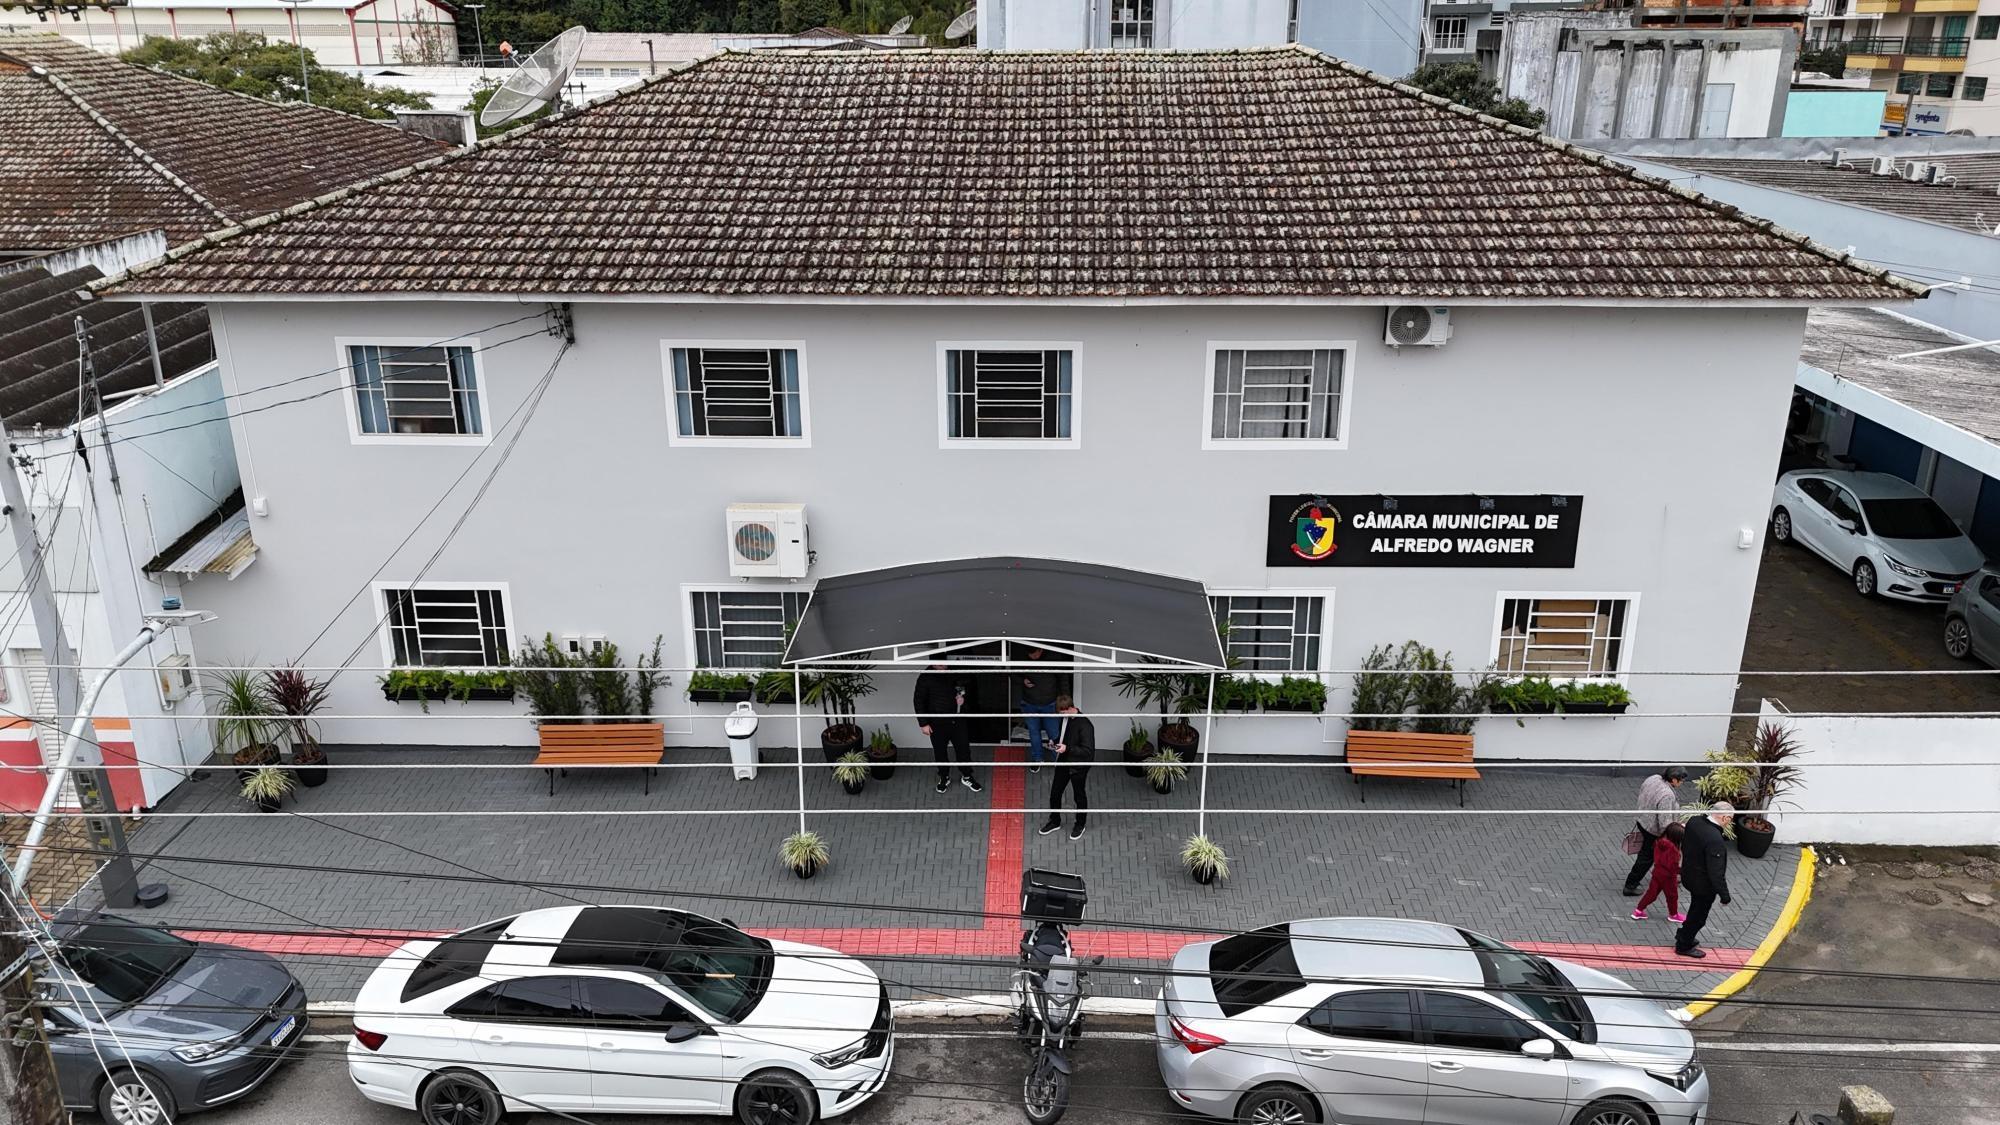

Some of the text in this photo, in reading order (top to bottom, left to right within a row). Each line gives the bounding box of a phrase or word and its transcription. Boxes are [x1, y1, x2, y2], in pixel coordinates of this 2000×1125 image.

[1915, 113, 1940, 124] syngenta
[1352, 511, 1559, 529] CÂMARA MUNICIPAL DE
[1370, 538, 1534, 553] ALFREDO WAGNER
